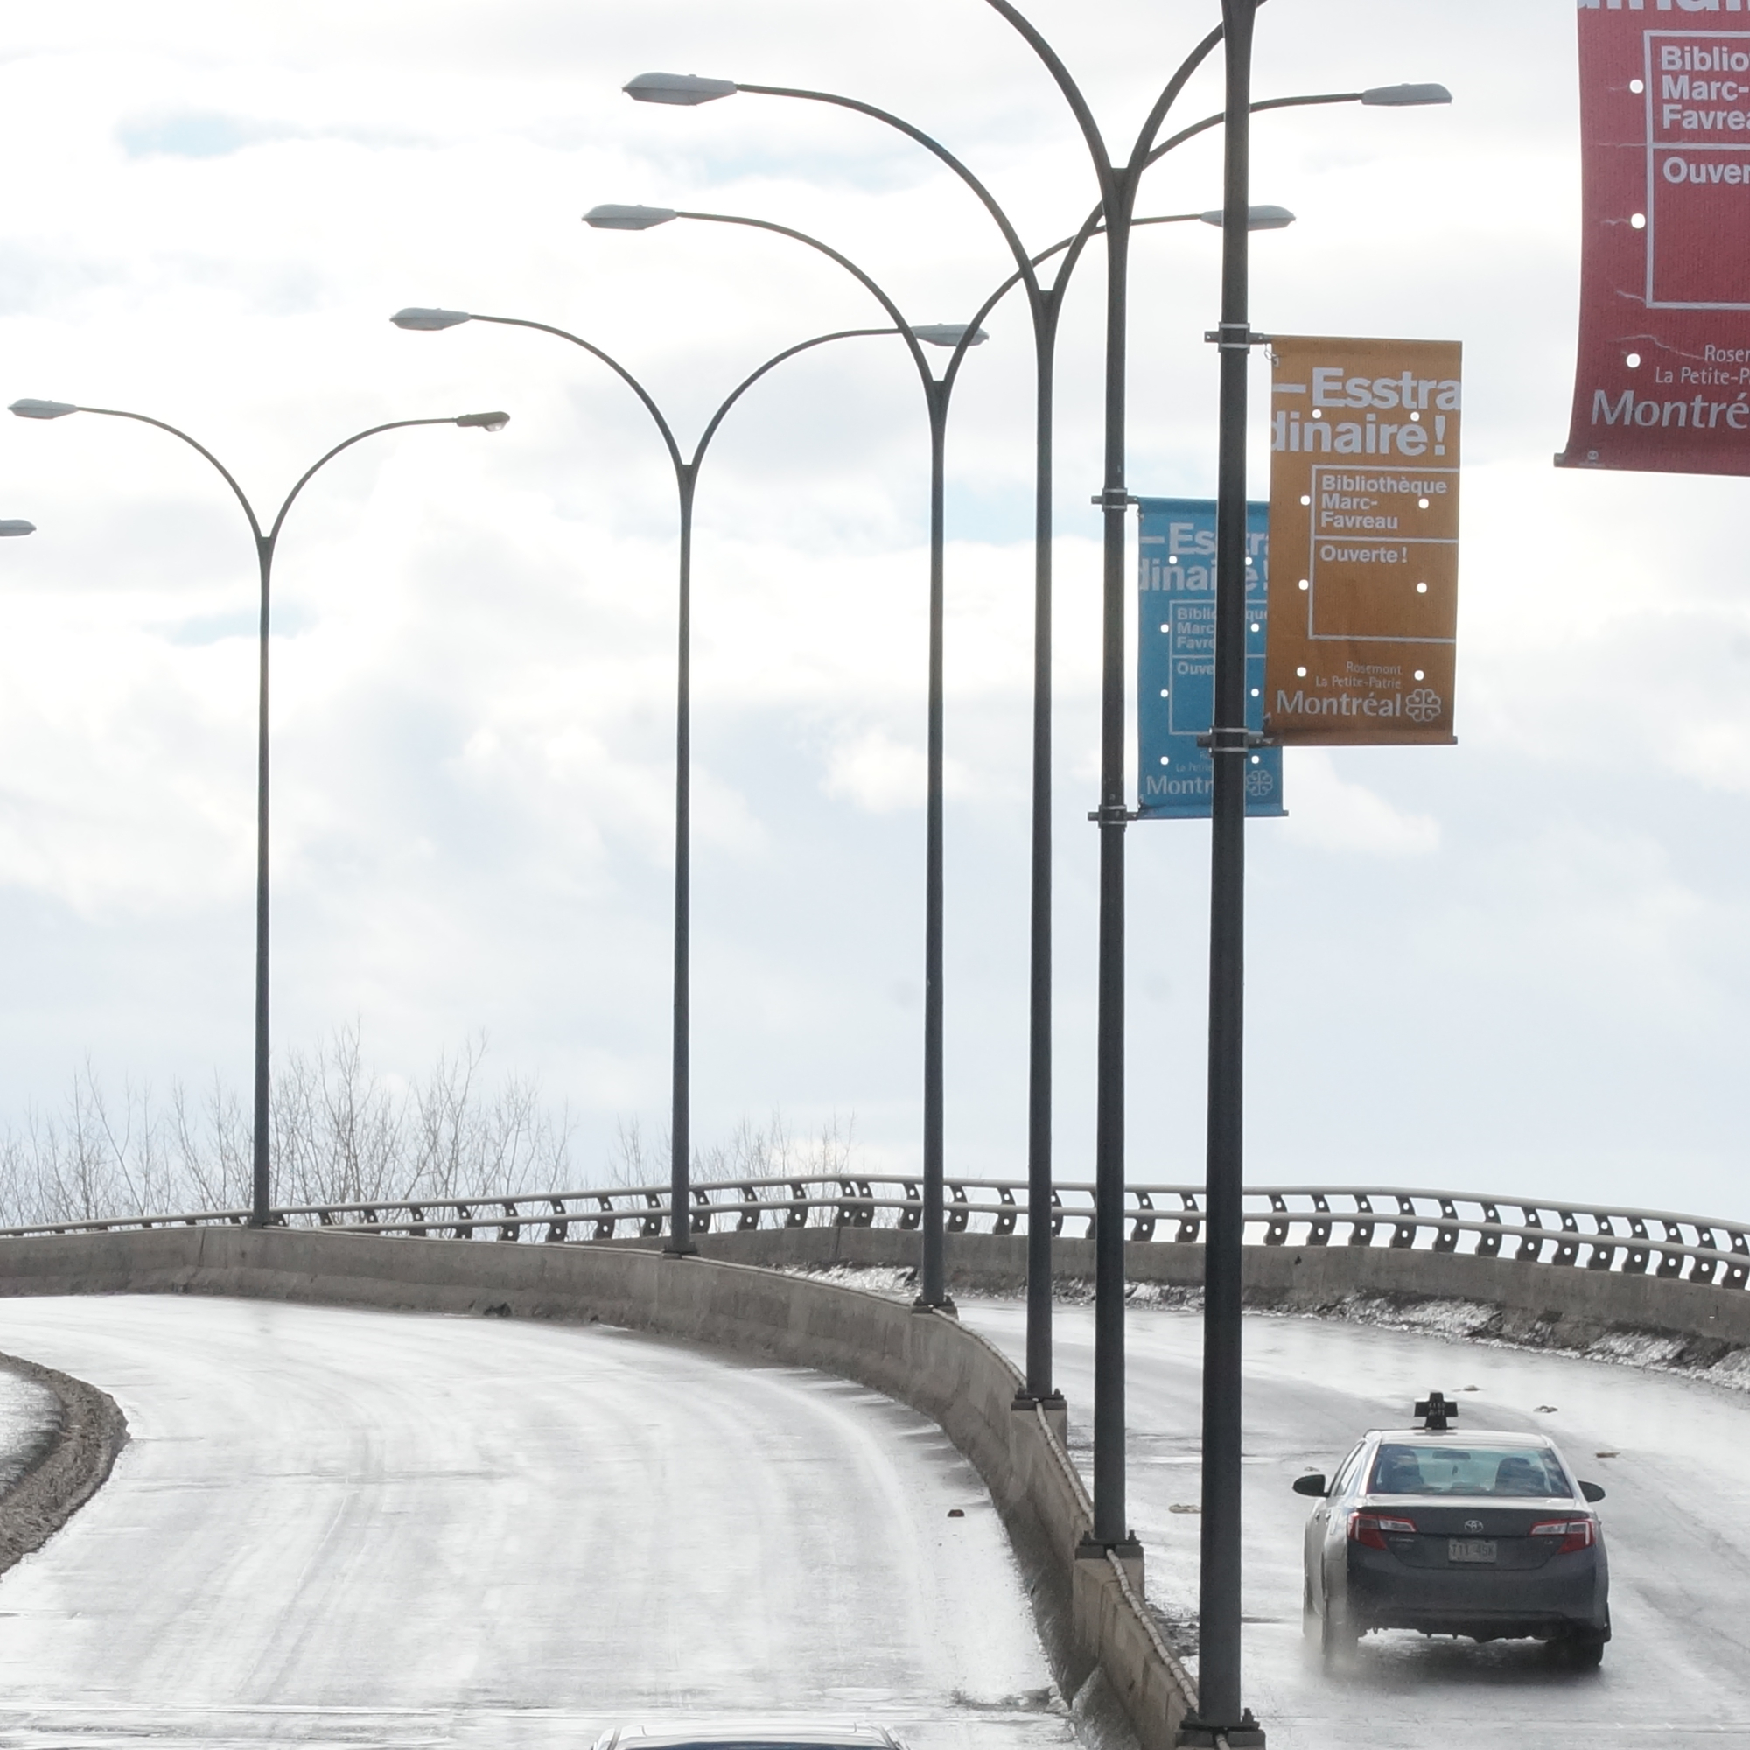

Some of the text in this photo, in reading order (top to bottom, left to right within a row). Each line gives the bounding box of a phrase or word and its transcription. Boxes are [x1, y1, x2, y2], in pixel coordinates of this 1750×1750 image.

[1662, 75, 1750, 102] Marc-
[1655, 366, 1673, 383] La
[1321, 474, 1447, 497] Bibliothèque
[1321, 493, 1379, 511] Marc-
[1320, 511, 1398, 530] Favreau
[1177, 621, 1215, 635] Marc
[1346, 660, 1404, 676] Rosemont
[1276, 689, 1401, 718] Montréal
